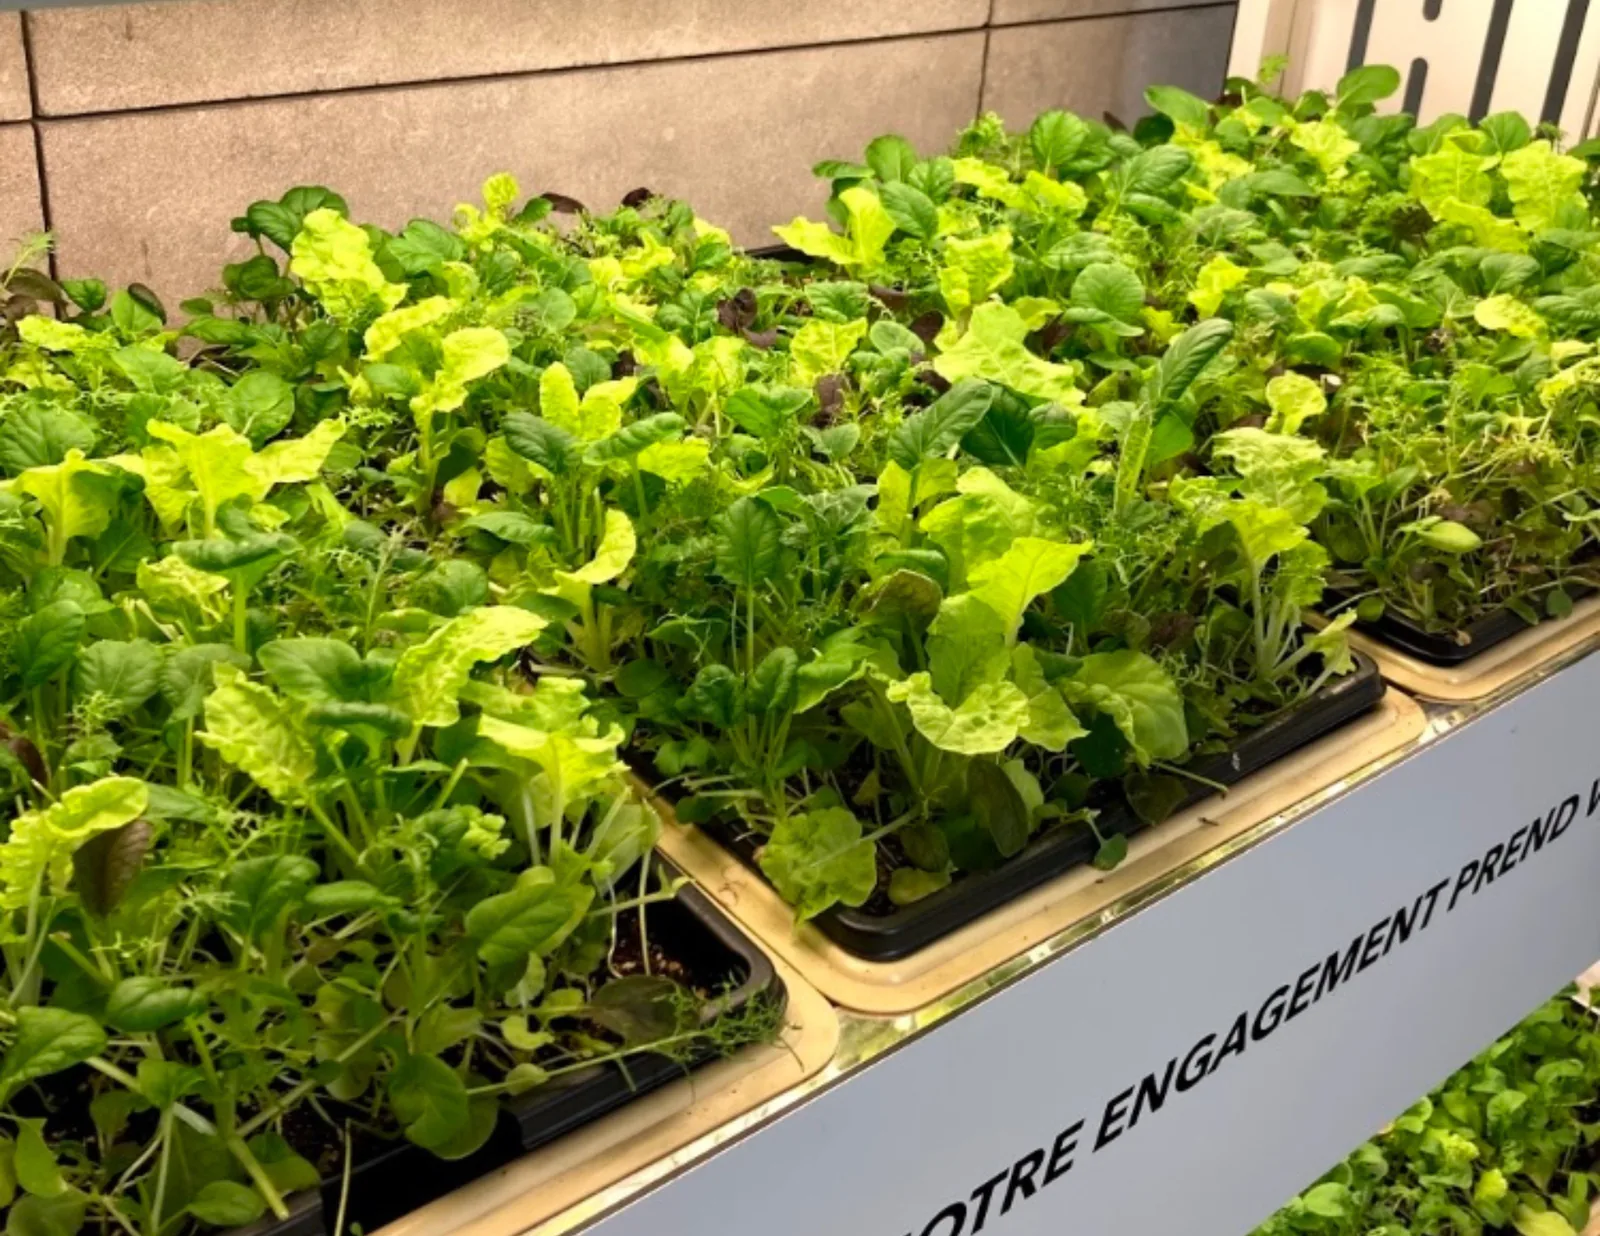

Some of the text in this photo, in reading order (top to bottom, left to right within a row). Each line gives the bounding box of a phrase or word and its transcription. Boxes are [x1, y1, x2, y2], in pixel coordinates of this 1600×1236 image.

[903, 794, 1579, 1236] OTRE ENGAGEMENT PREND
